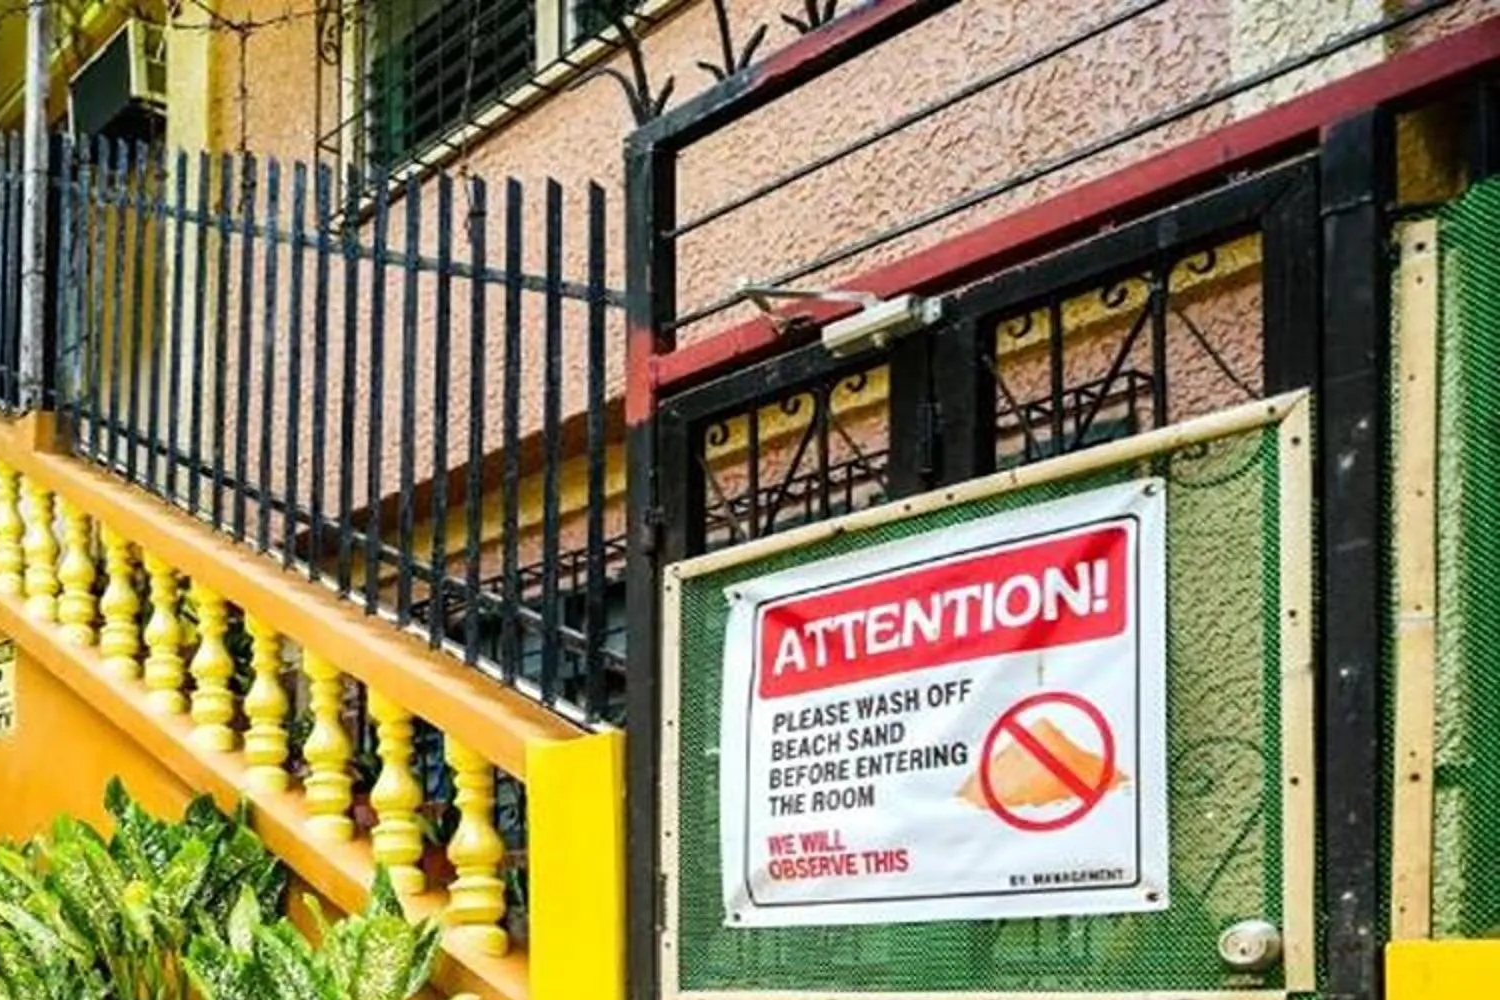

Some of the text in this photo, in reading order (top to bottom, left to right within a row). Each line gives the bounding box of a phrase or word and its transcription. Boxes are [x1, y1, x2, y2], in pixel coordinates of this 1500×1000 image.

[773, 560, 1109, 675] ATTENTION!
[772, 679, 974, 735] PLEASE WASH OFF
[771, 722, 905, 761] BEACH SAND
[769, 742, 969, 790] BEFORE ENTERING
[768, 784, 875, 817] THE ROOM
[768, 829, 847, 856] WE WILL
[768, 848, 909, 881] OBSERVE THIS
